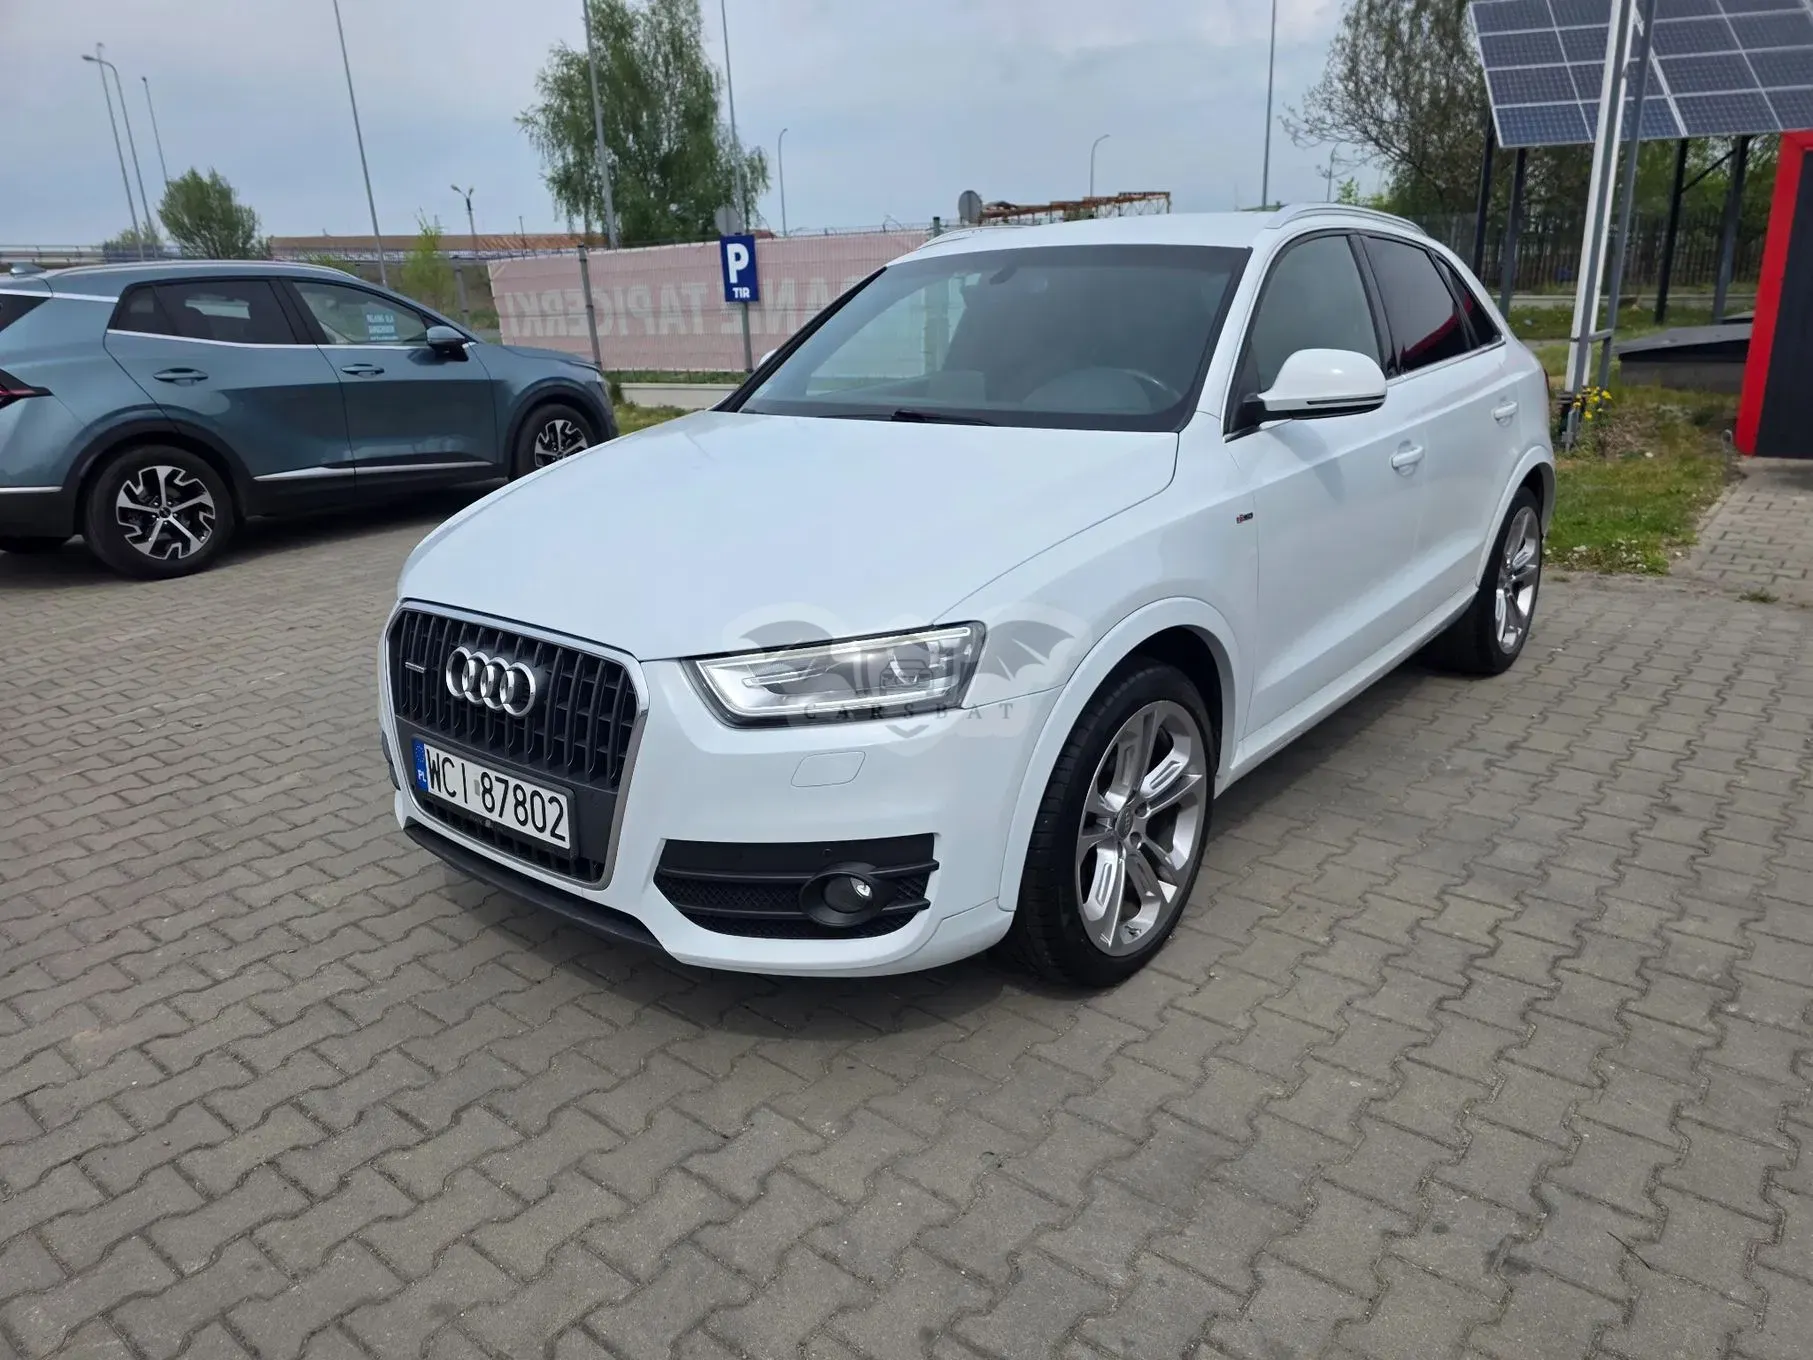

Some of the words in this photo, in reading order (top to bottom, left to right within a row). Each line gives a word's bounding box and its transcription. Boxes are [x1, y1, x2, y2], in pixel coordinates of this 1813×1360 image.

[727, 243, 749, 284] P
[732, 287, 750, 299] TIR
[417, 769, 427, 783] PL
[426, 748, 468, 804] WCI
[480, 771, 567, 842] 87802
